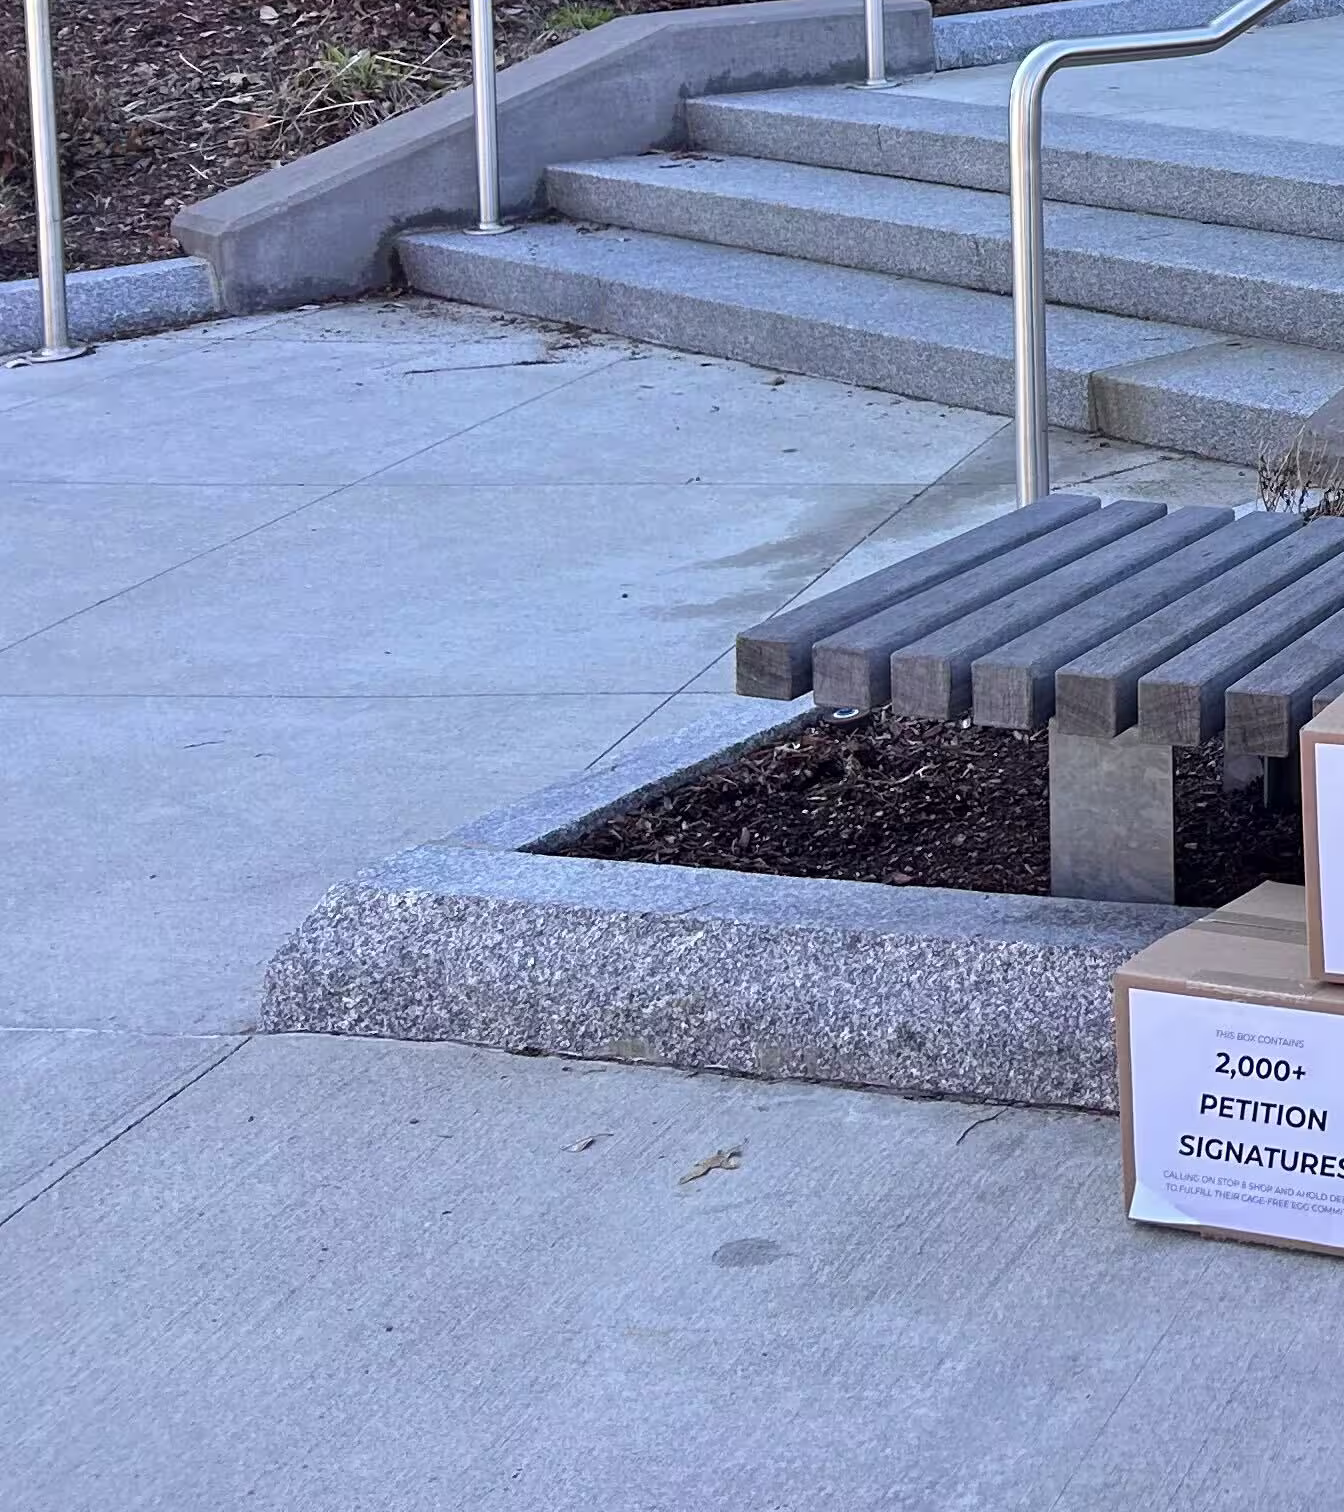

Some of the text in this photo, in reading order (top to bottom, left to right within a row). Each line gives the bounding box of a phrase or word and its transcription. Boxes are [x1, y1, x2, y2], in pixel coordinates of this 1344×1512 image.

[1215, 1029, 1303, 1048] THIS BOX CONTAINS
[1215, 1052, 1305, 1081] 2,000+
[1200, 1094, 1327, 1131] PETITION
